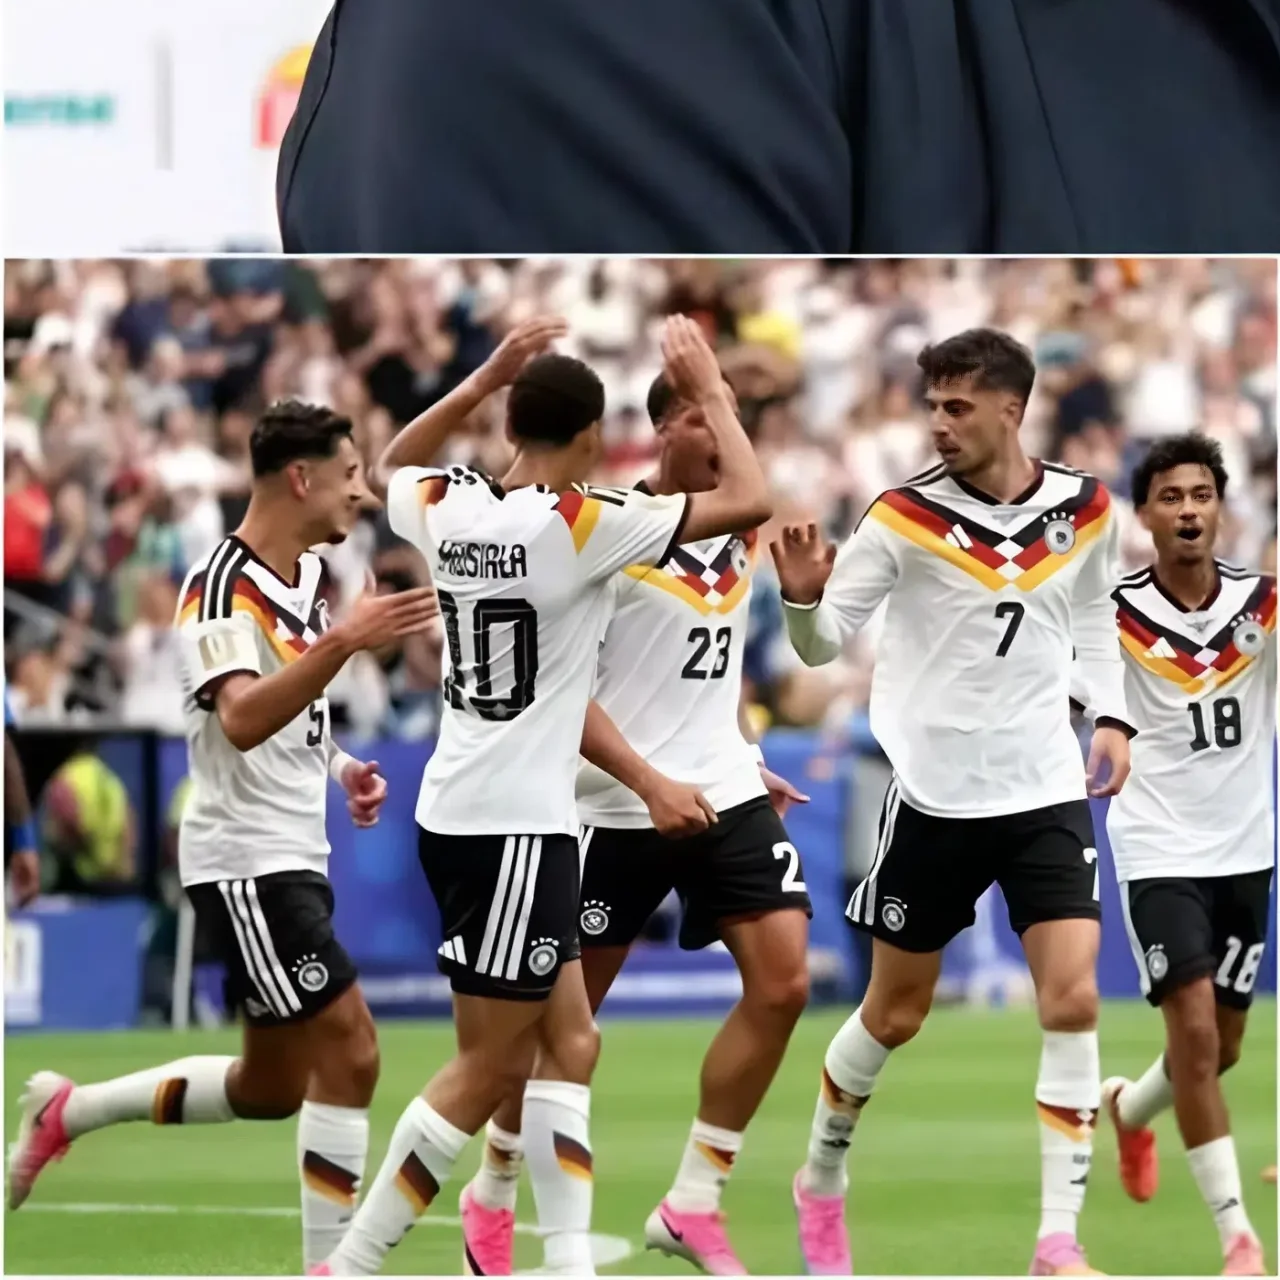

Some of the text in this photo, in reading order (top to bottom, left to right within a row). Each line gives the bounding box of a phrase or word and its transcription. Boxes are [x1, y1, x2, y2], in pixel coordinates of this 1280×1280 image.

[681, 626, 732, 680] 23
[994, 601, 1025, 657] 7
[1187, 696, 1242, 751] 18
[1215, 936, 1266, 994] 18
